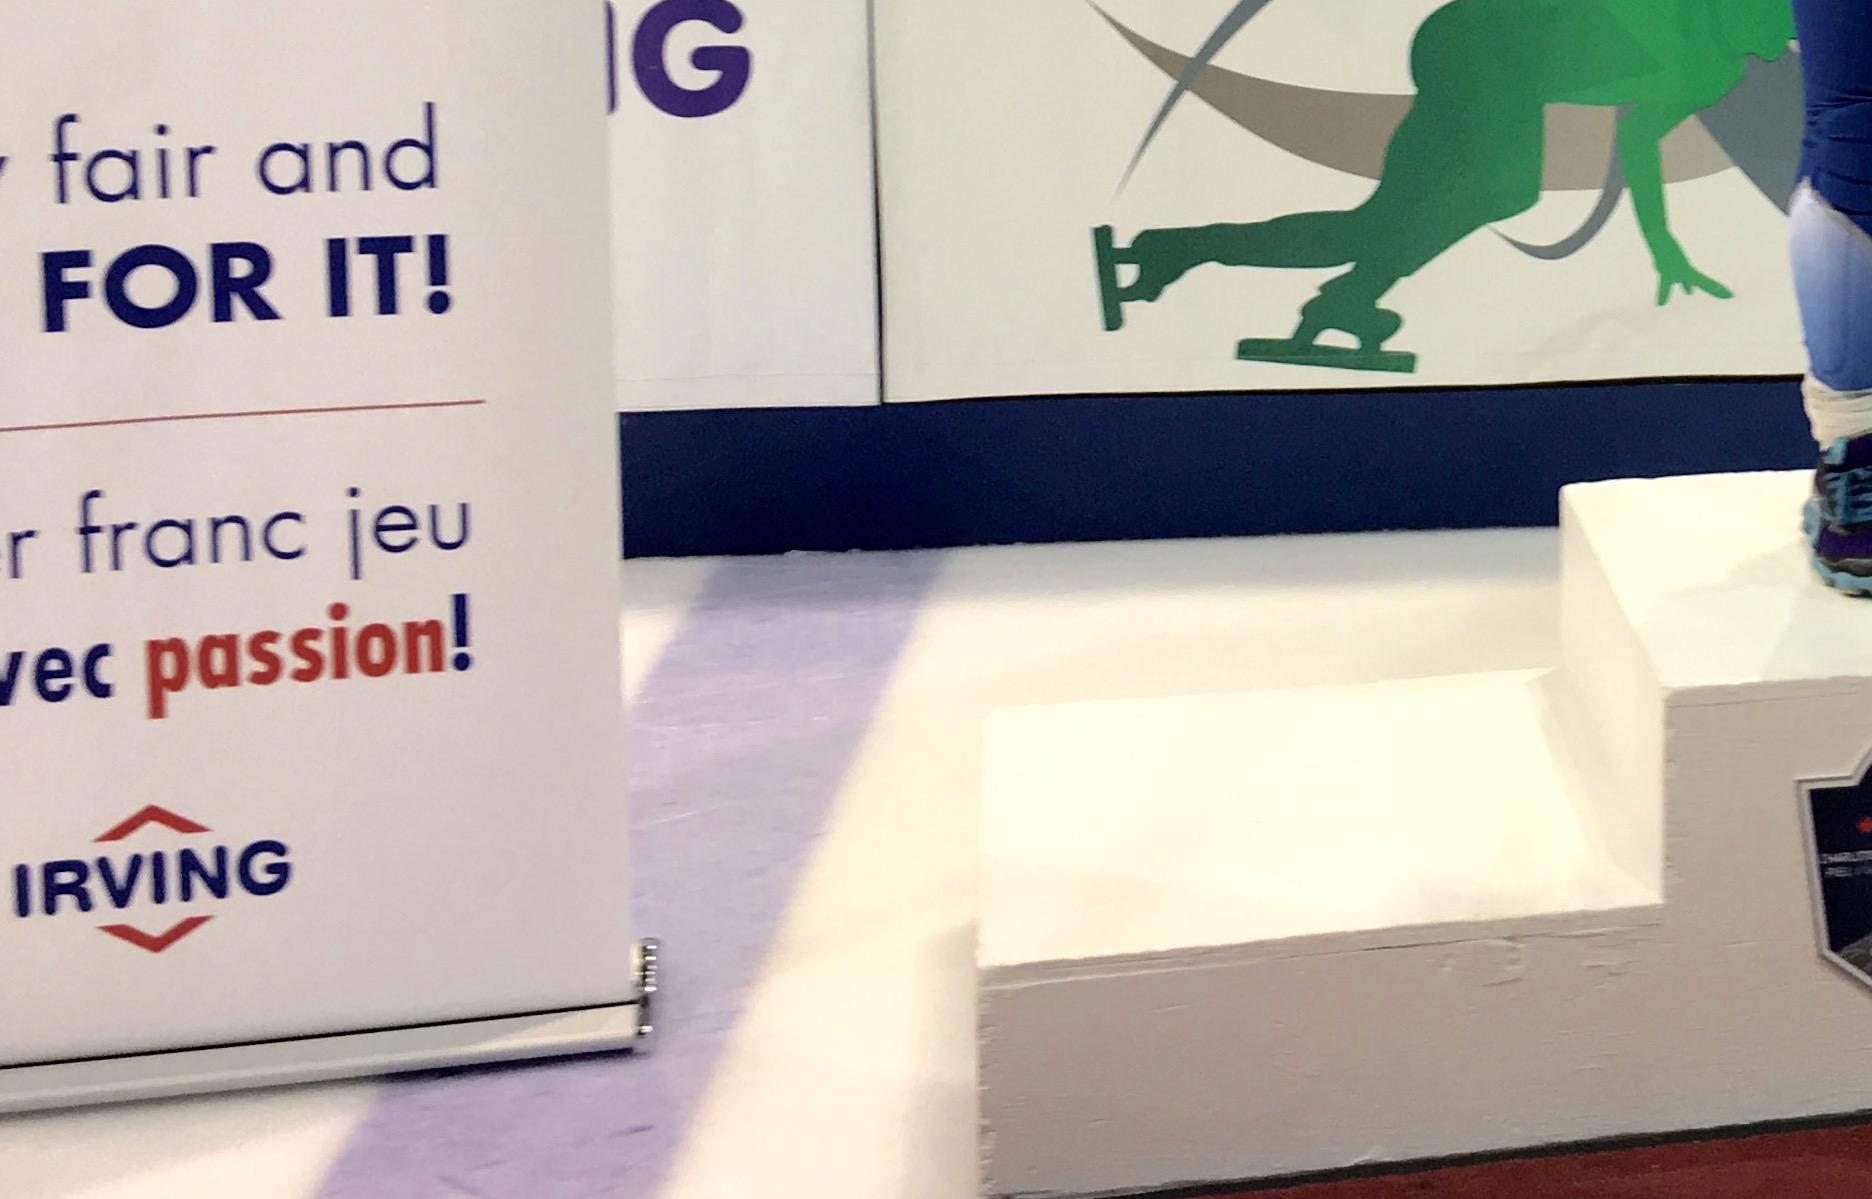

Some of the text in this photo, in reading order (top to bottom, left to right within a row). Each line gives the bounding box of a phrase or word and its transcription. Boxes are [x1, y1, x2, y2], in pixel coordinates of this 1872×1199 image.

[50, 101, 438, 204] fair and
[40, 234, 452, 333] FOR IT!
[76, 489, 308, 573] franc
[348, 487, 470, 581] jeu
[0, 593, 474, 720] vec passion!
[14, 840, 292, 918] IRVING
